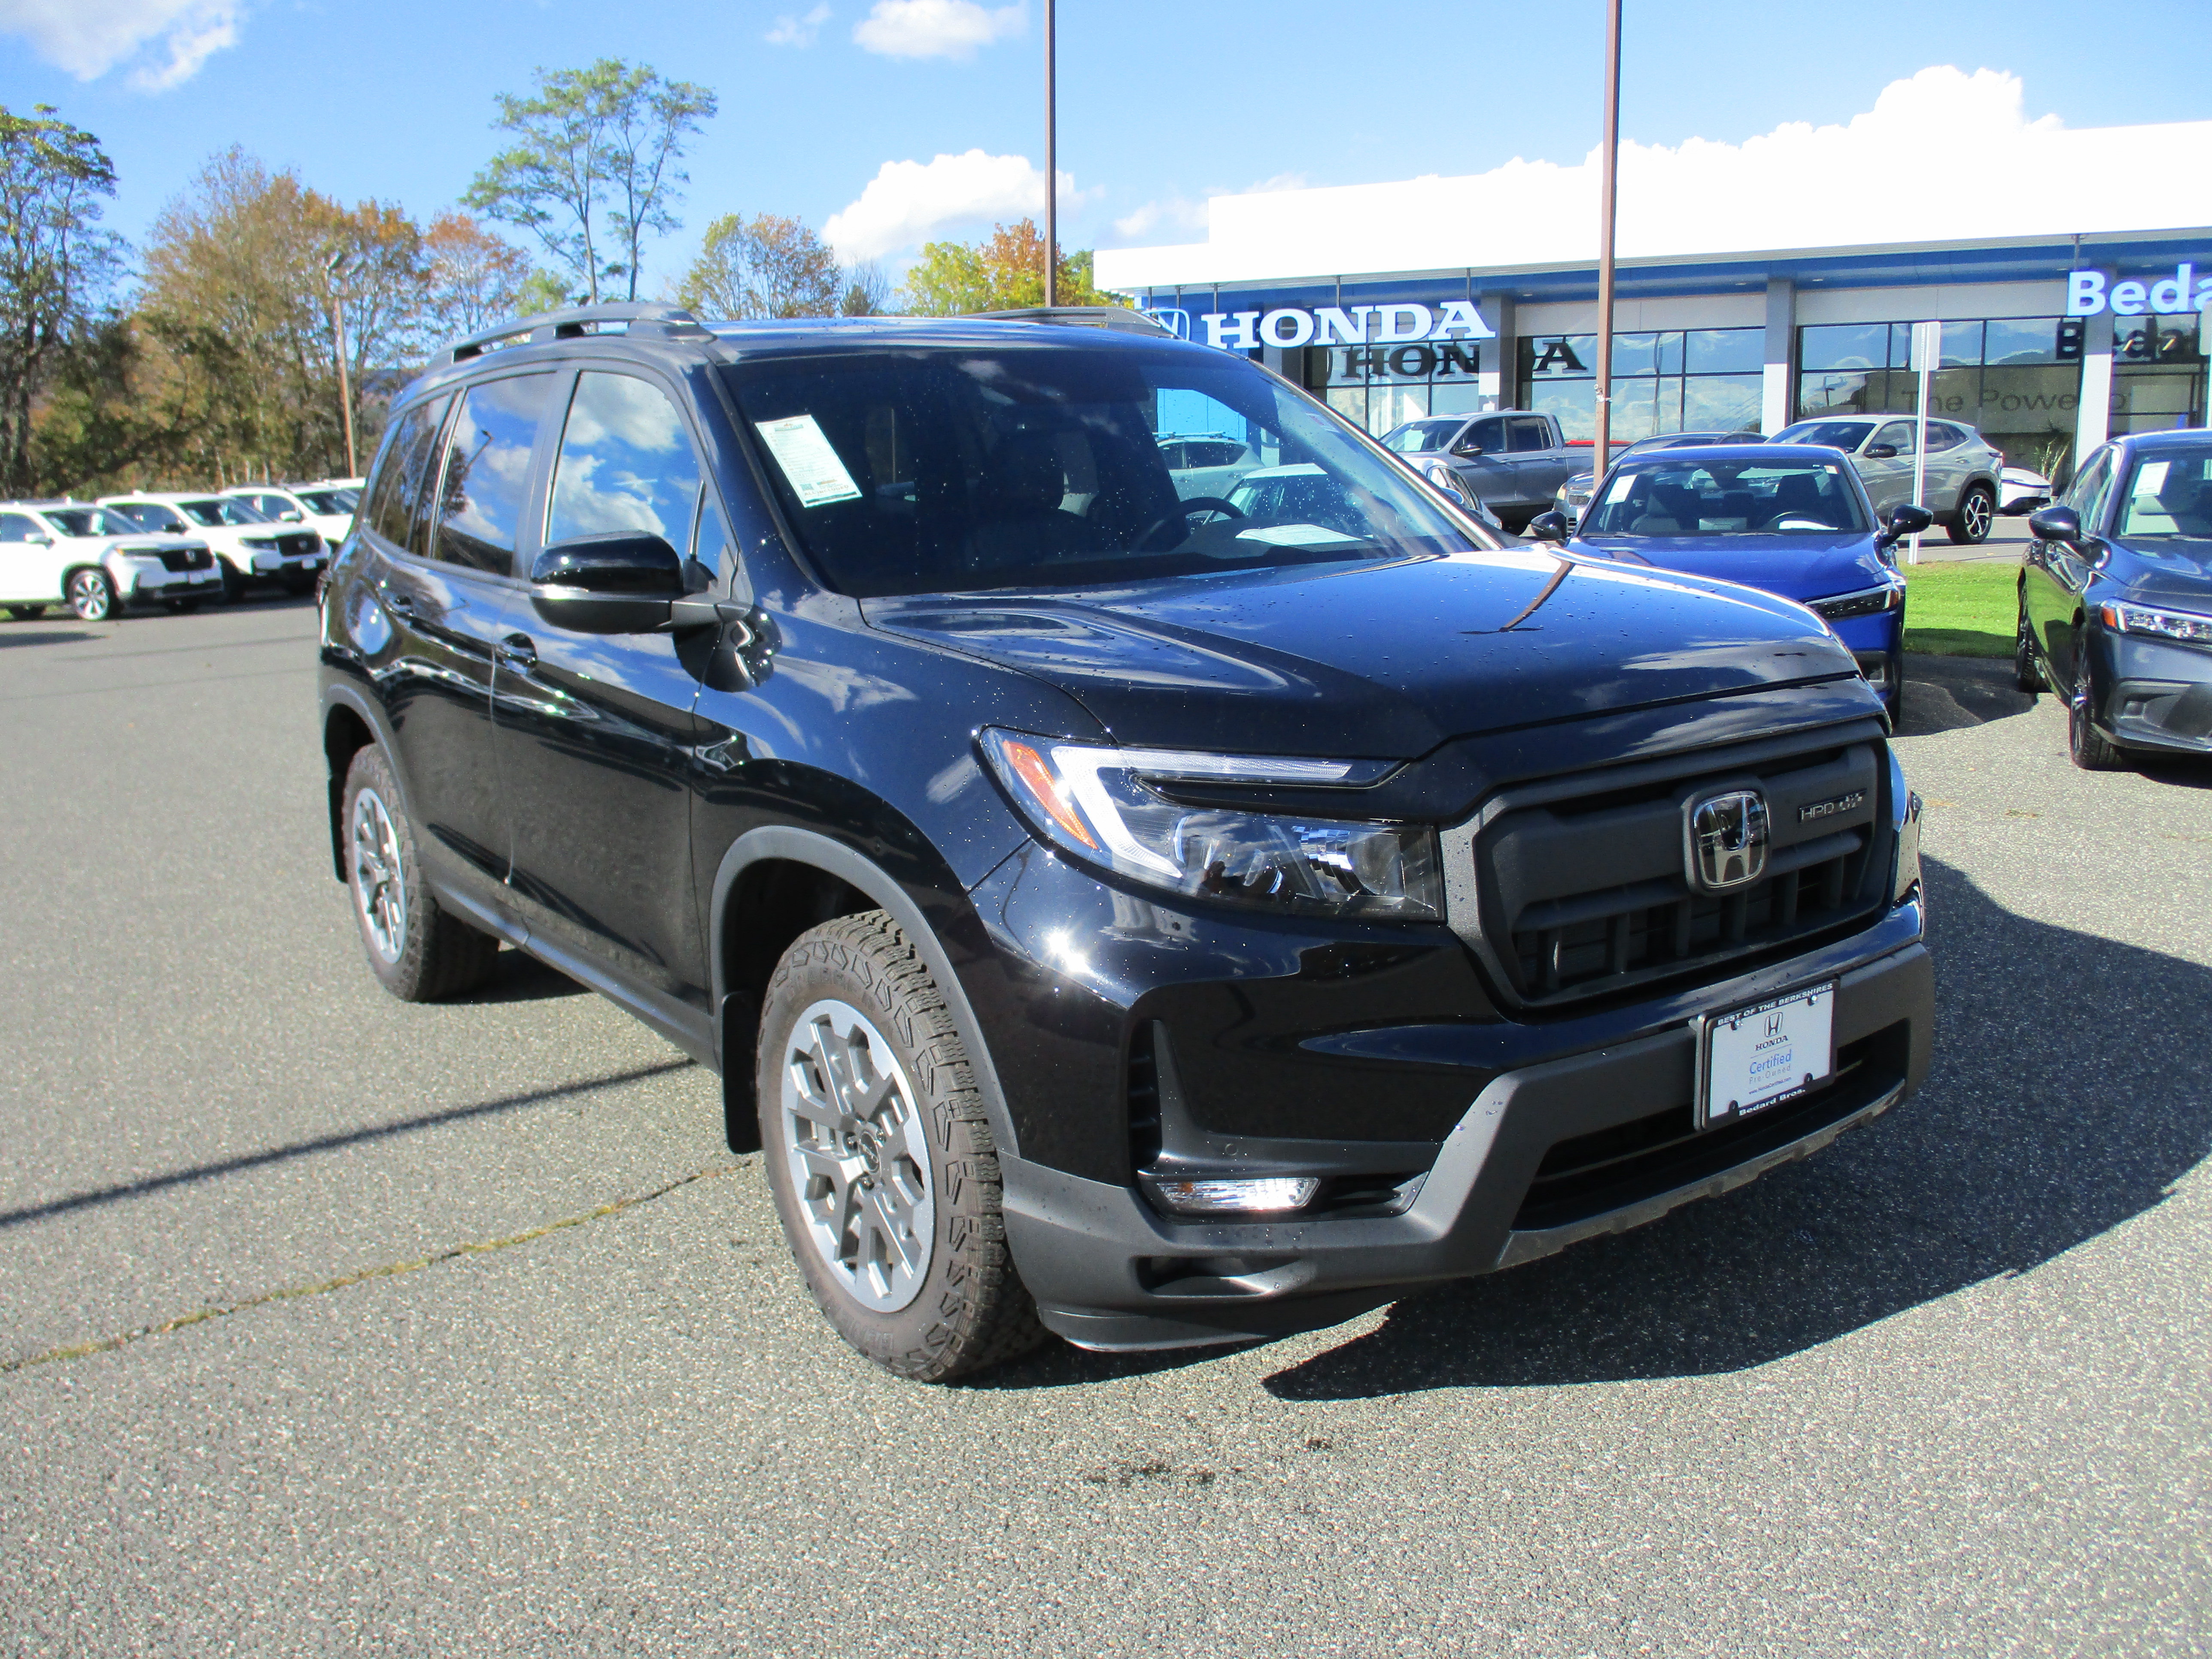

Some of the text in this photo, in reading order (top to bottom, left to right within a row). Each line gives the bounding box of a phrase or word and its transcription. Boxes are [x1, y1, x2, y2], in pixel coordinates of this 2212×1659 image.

[1201, 301, 1496, 349] HONDA
[1980, 388, 2078, 411] Powe
[1801, 802, 1835, 820] HPD
[1718, 983, 1833, 1025] BEST OF THE BERKSHIRES
[1754, 1035, 1789, 1051] HONDA
[1750, 1049, 1792, 1074] Certified
[1749, 1064, 1791, 1084] Pre-Owned
[1738, 1089, 1805, 1116] Bedard Bros.
